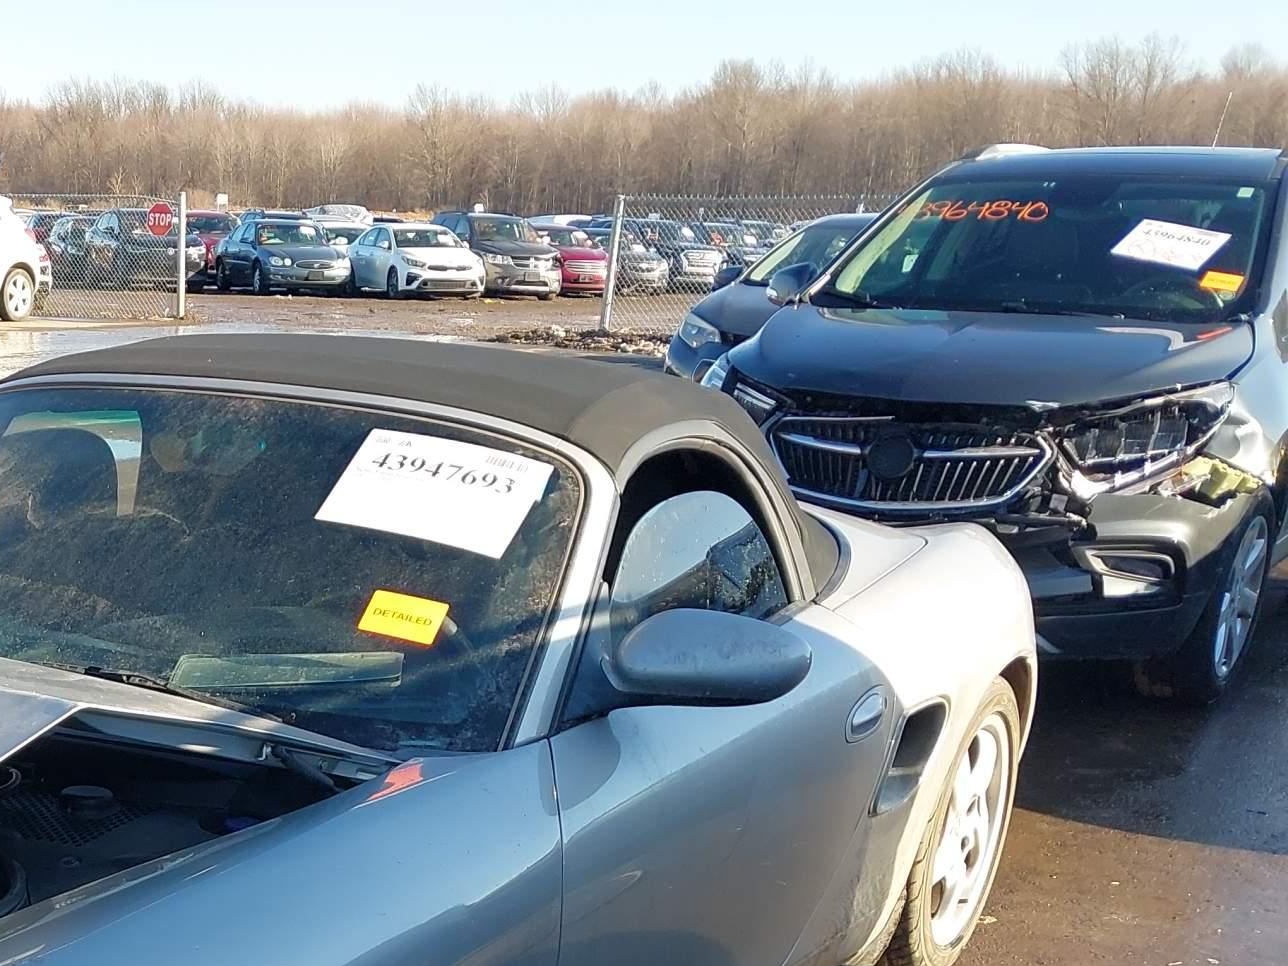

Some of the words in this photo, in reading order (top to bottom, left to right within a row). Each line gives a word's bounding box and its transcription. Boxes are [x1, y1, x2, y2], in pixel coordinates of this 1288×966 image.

[148, 212, 172, 227] STOP
[371, 452, 516, 494] 43947693
[372, 607, 433, 627] DETAILED
